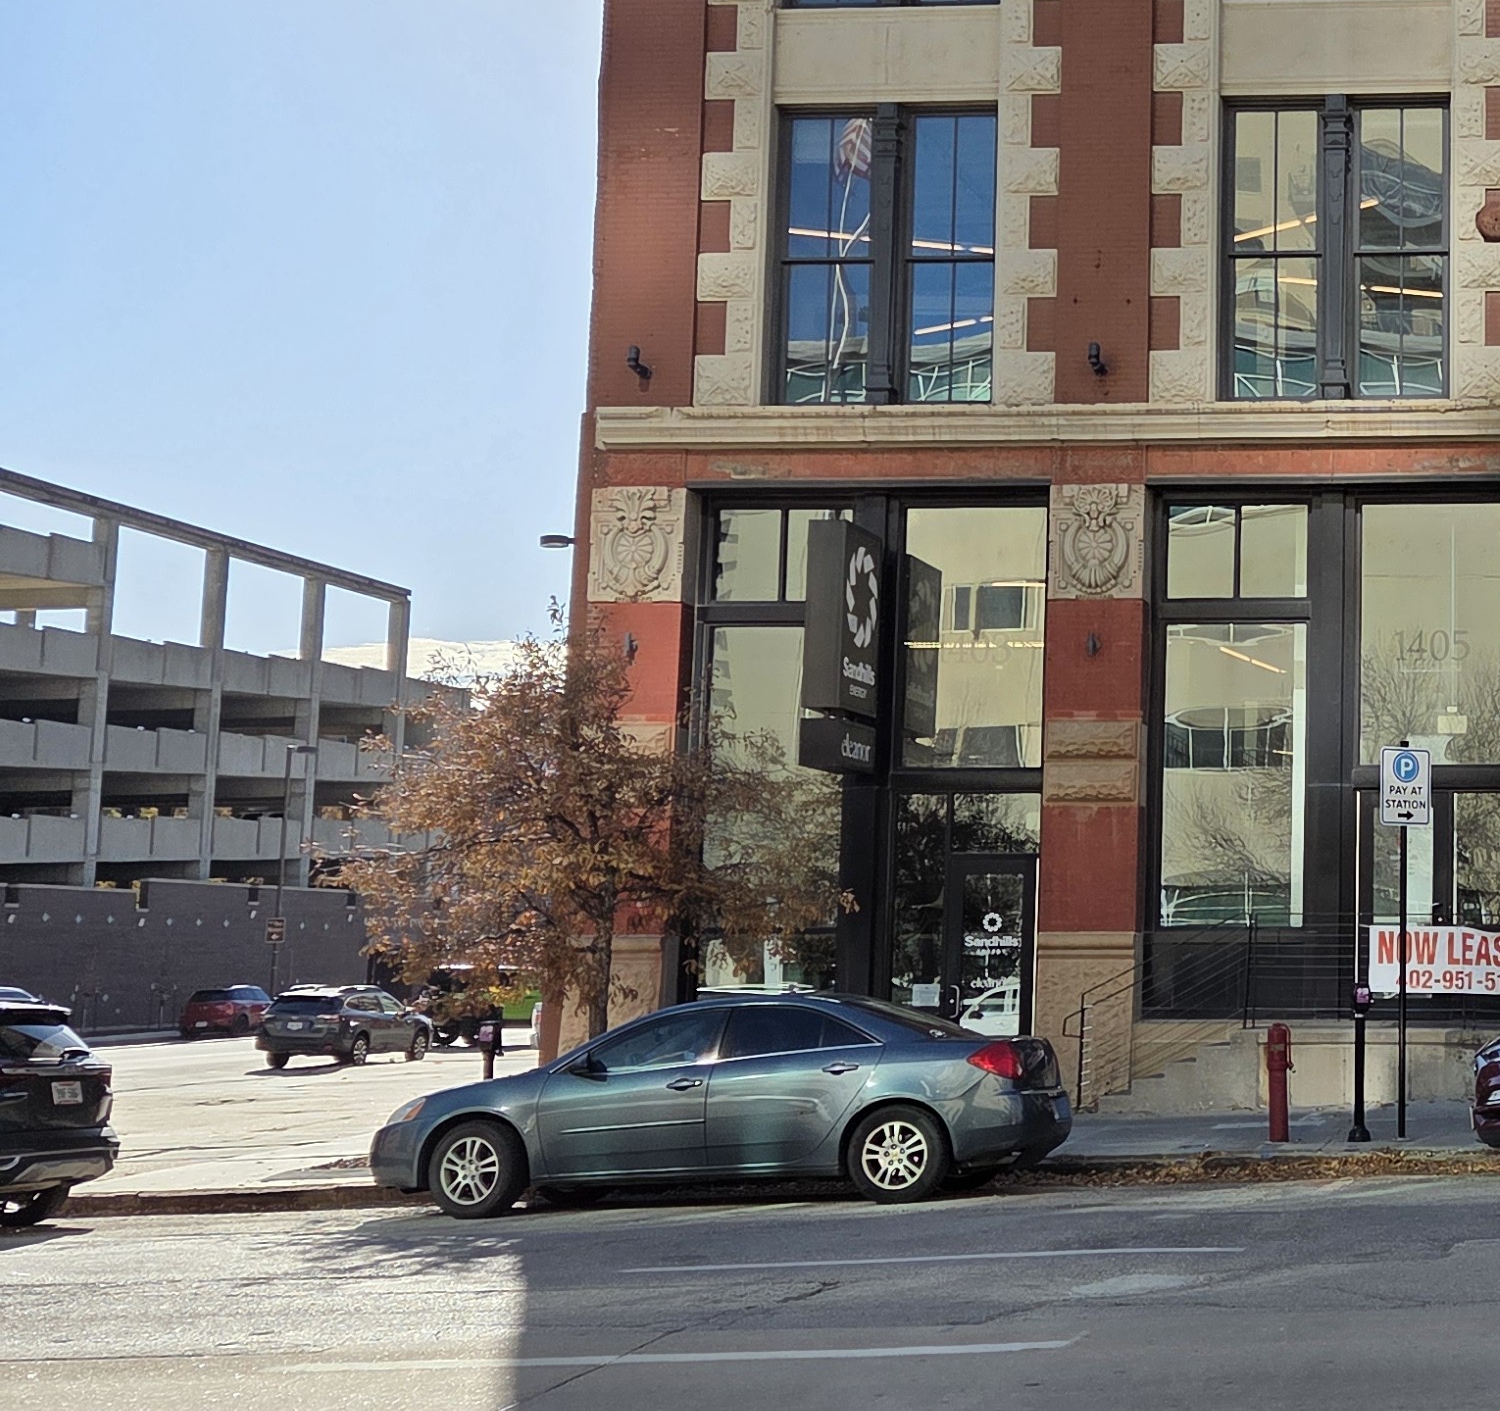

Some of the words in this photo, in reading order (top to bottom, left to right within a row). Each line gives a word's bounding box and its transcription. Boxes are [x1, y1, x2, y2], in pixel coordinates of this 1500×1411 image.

[1395, 629, 1471, 662] 1405
[1389, 785, 1408, 796] PAY
[1410, 786, 1423, 796] AT
[1385, 799, 1426, 809] STATION
[1378, 930, 1439, 965] NOW
